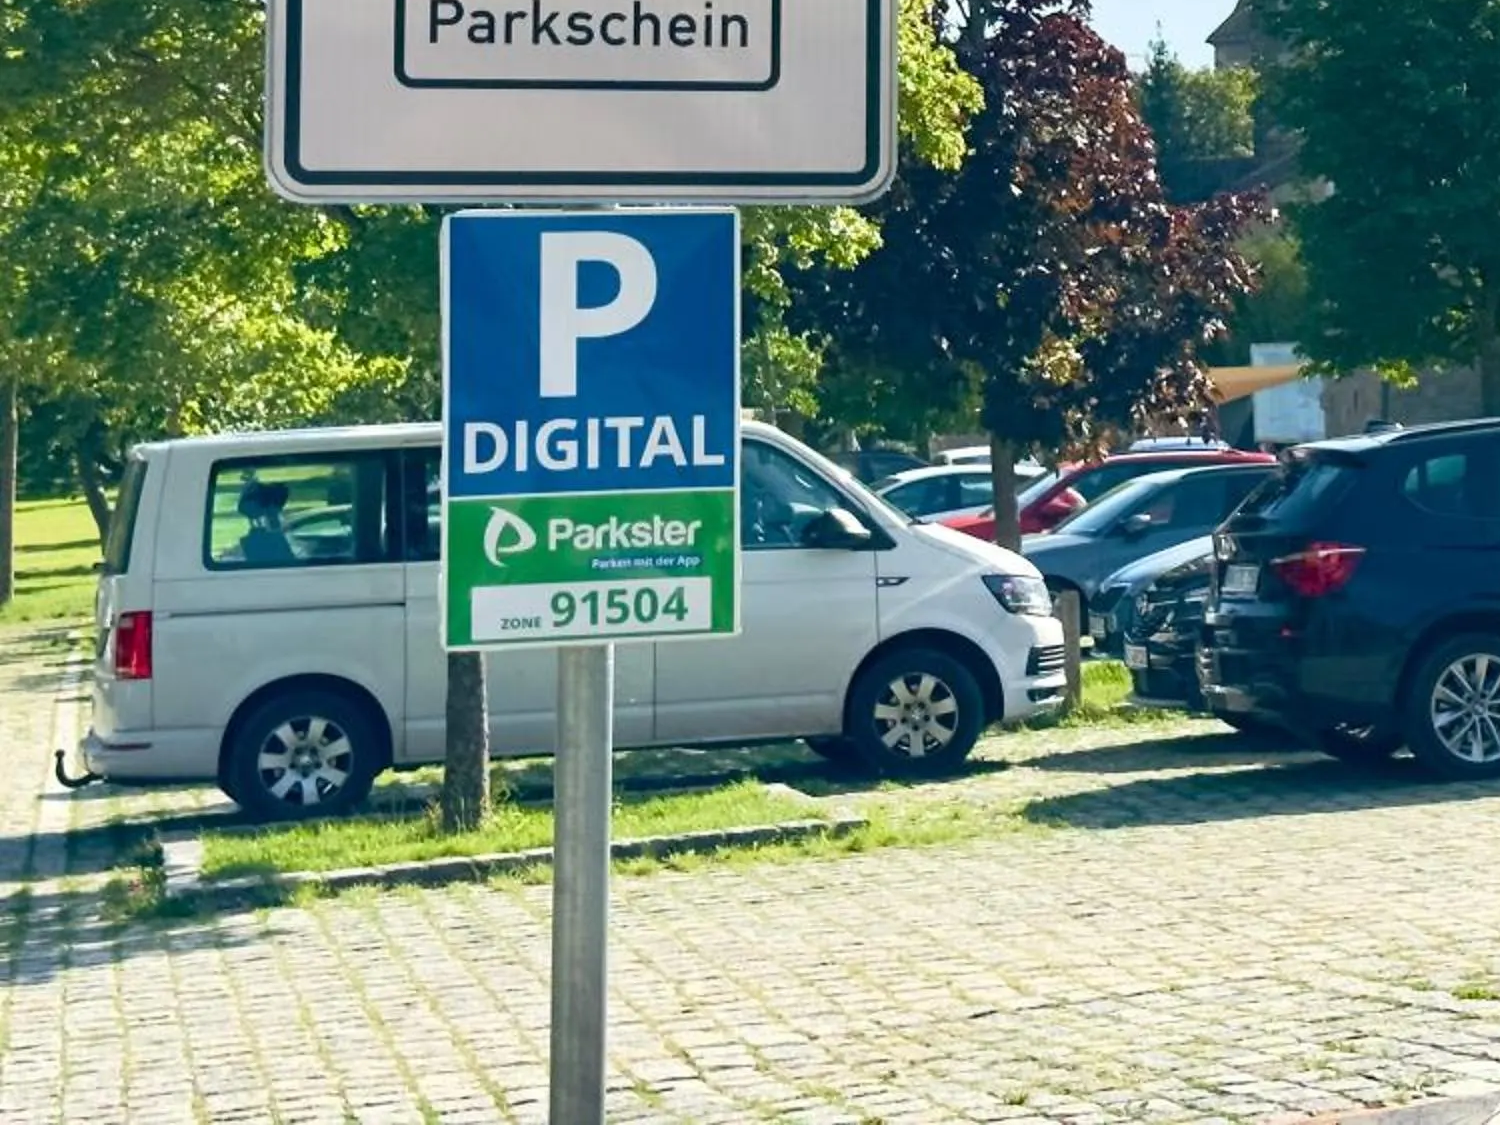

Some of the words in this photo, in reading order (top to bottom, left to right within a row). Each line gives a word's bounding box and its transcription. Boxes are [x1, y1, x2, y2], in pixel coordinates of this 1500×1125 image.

[539, 230, 658, 398] P
[463, 414, 725, 474] DIGITAL
[548, 514, 702, 551] Parkster
[656, 555, 674, 566] der
[677, 555, 701, 568] App
[500, 616, 542, 631] ZONE
[550, 586, 689, 628] 91504
